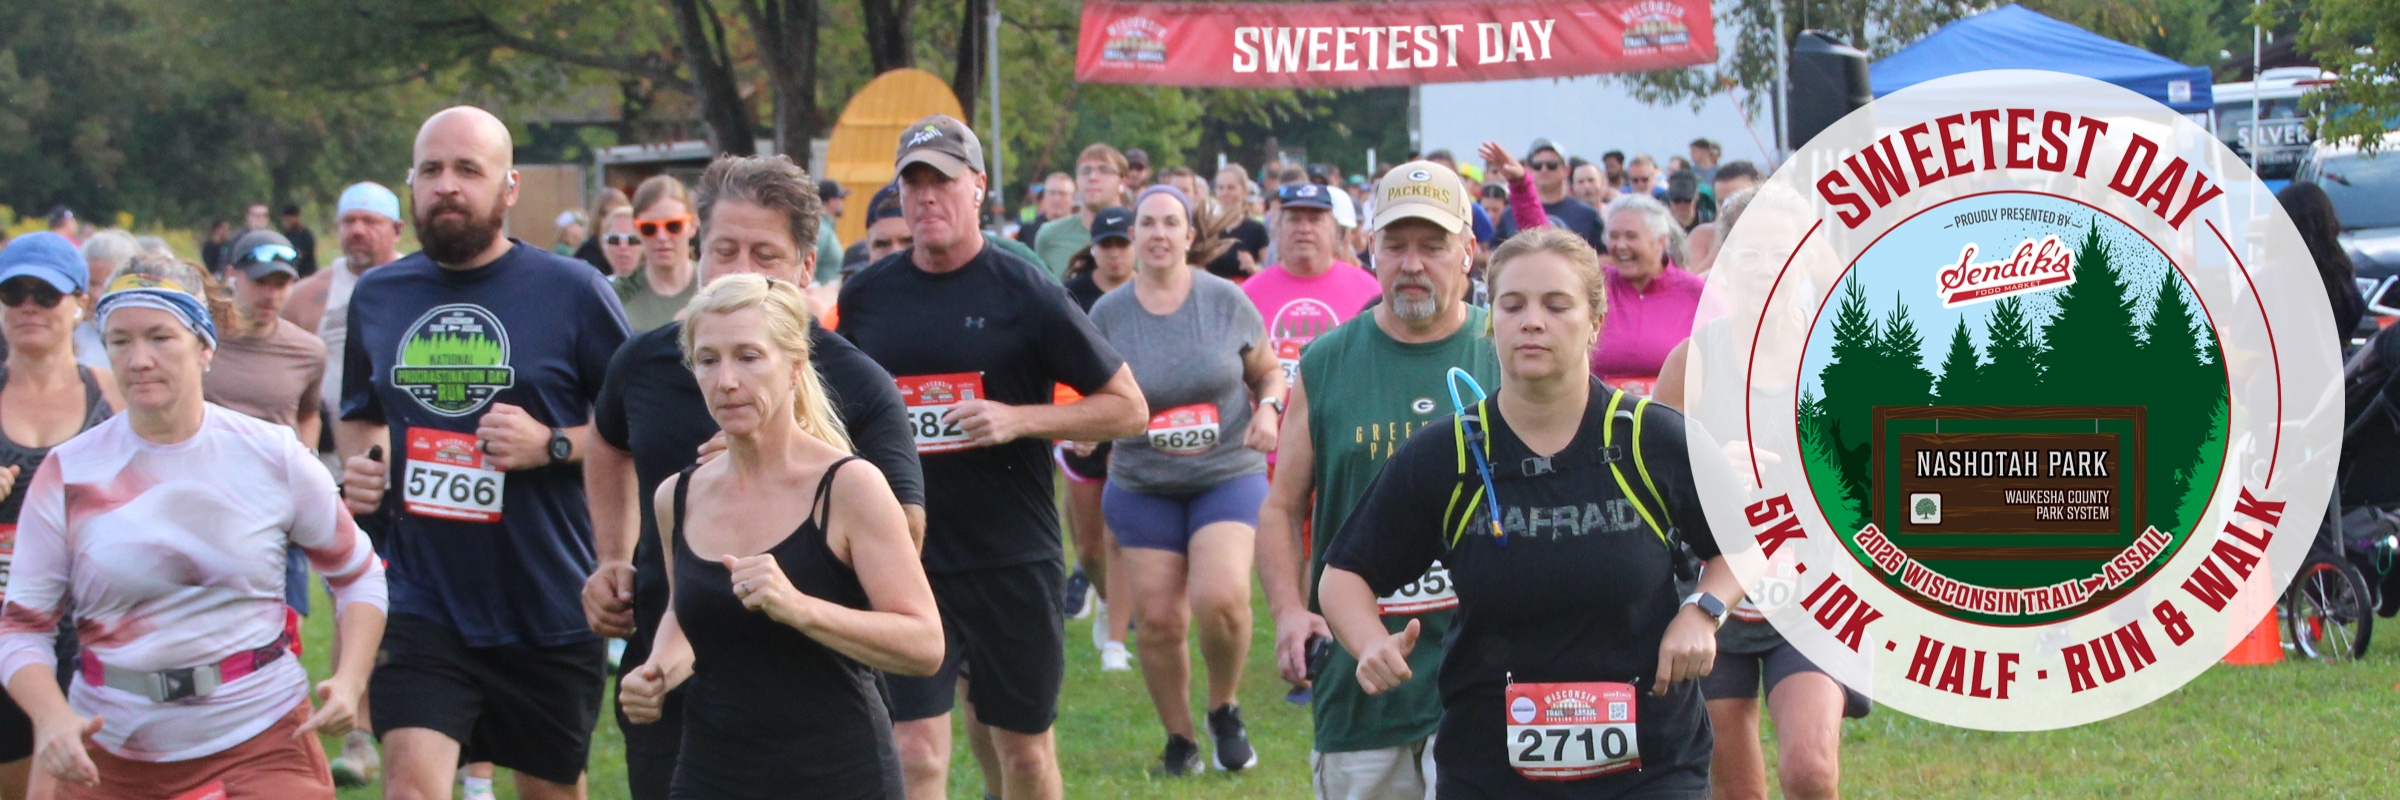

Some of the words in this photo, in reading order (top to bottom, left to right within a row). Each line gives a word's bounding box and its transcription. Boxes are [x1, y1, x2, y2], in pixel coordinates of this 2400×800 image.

[1232, 24, 1463, 73] SWEETEST
[1476, 19, 1556, 65] DAY
[2237, 125, 2311, 147] SLVER
[1388, 184, 1450, 204] PACKERS
[438, 384, 466, 401] RUN
[1154, 429, 1215, 448] 5629
[1356, 421, 1428, 443] GREE
[408, 467, 495, 506] 5766
[1543, 690, 1597, 705] WISCONSIN
[1517, 727, 1628, 762] 2710
